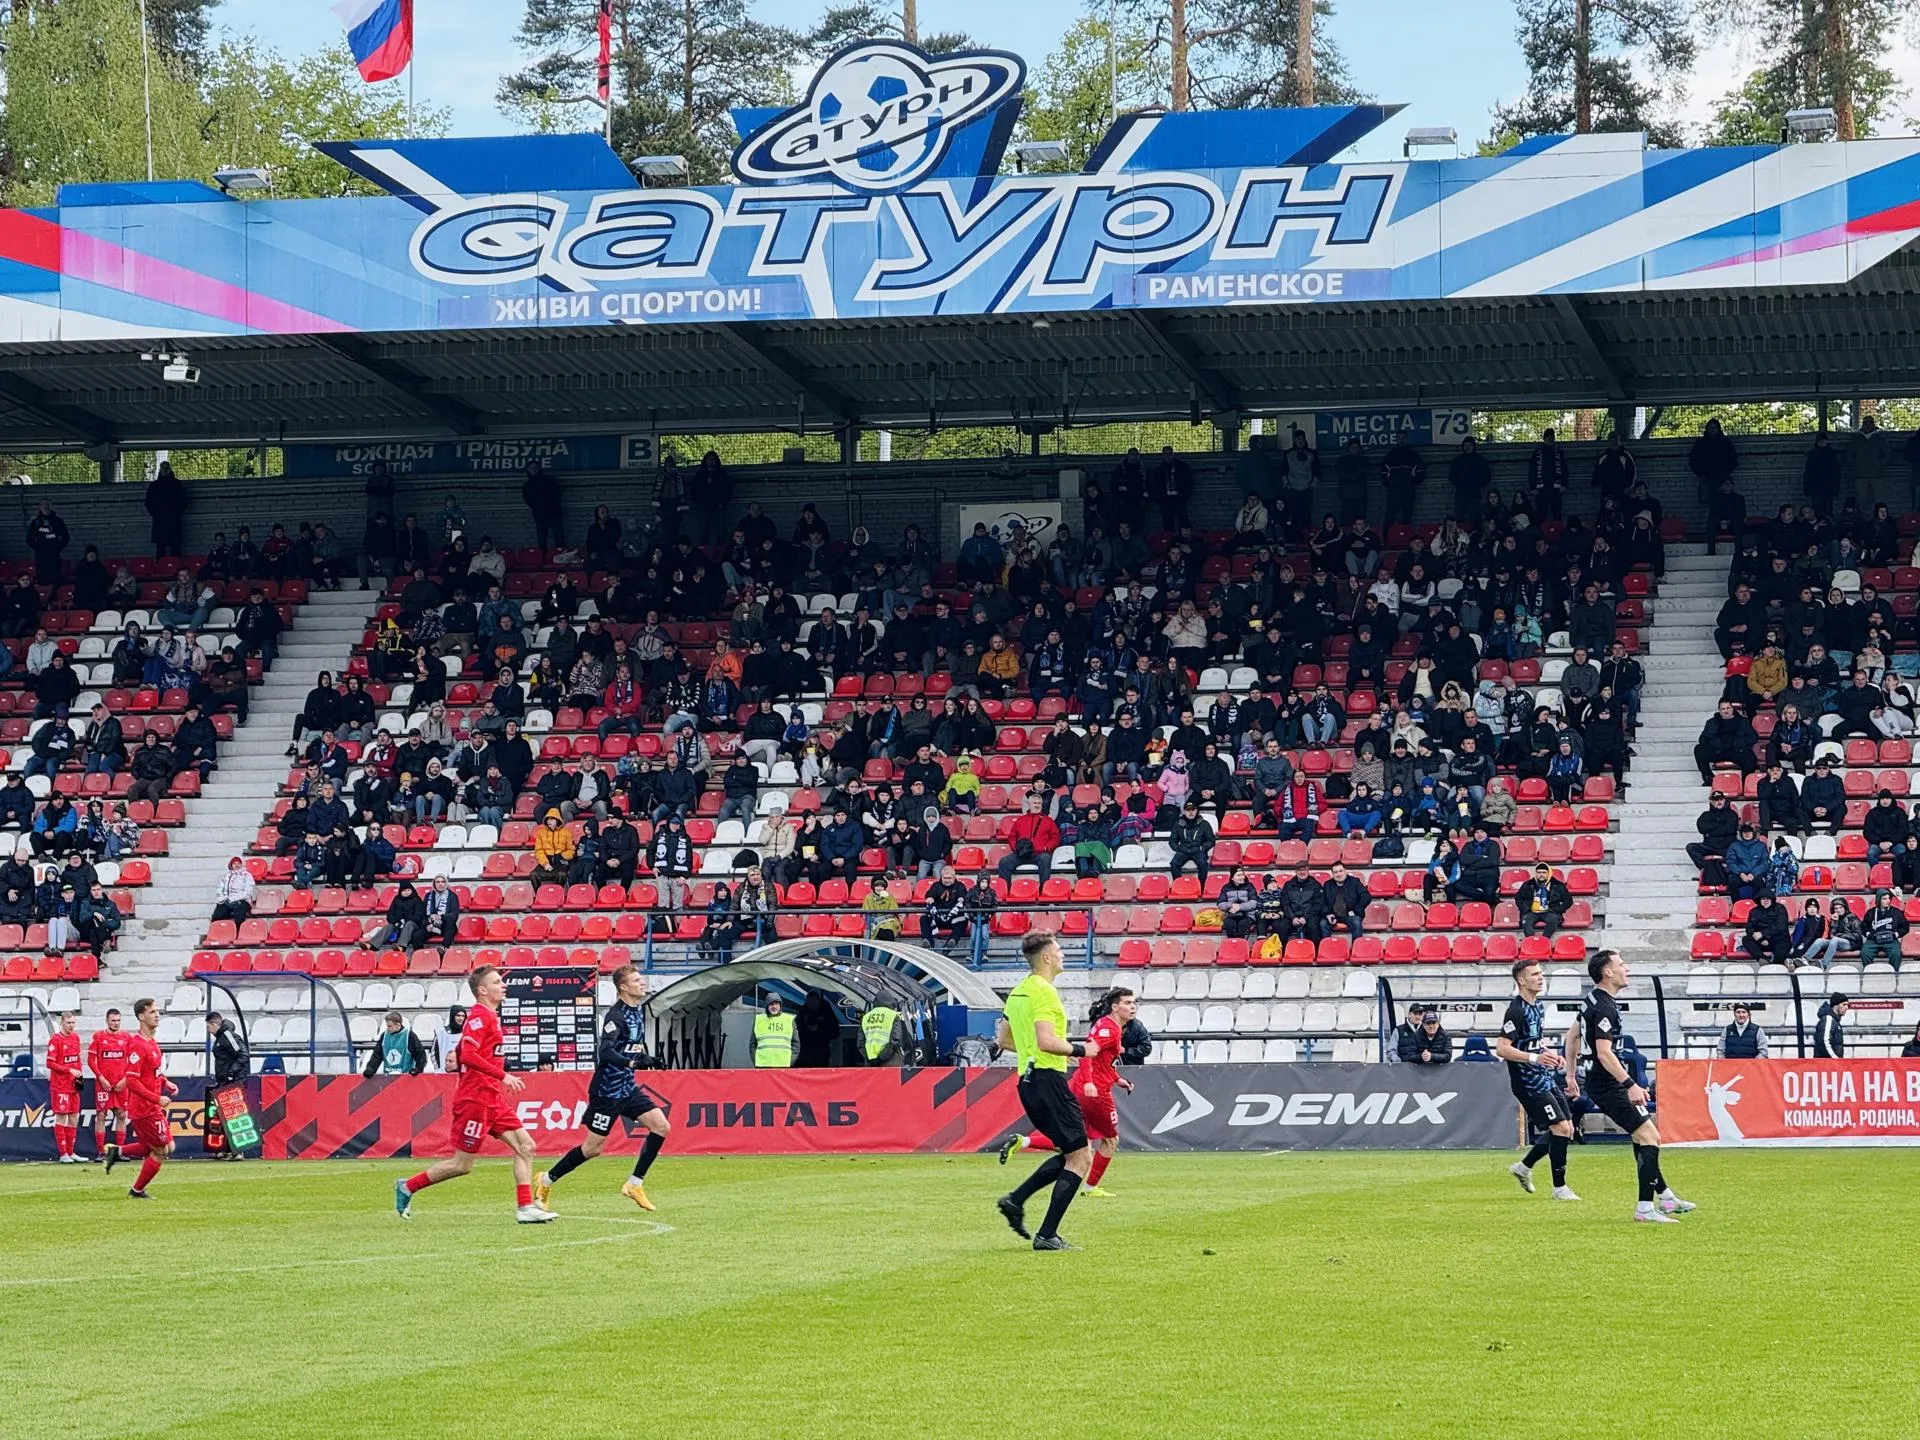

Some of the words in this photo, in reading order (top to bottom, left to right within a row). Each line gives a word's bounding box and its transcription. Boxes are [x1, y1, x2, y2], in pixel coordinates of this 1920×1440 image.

[1148, 273, 1344, 301] РАМЕНСКОЕ
[496, 294, 590, 322] ЖИВИ
[601, 287, 763, 318] СПОРТОМ!
[1332, 413, 1415, 434] МЕСТА
[1434, 412, 1469, 436] 73
[336, 442, 434, 462] ЮЖНАЯ
[352, 461, 413, 475] SOTH
[470, 457, 553, 470] TRIBUE
[1436, 1004, 1478, 1012] LEON
[768, 1022, 784, 1032] 4164
[867, 1013, 886, 1024] 4533
[58, 1093, 69, 1104] 74
[97, 1092, 109, 1102] 83
[1782, 1070, 1857, 1107] ОДНА
[1863, 1071, 1900, 1103] НА
[687, 1101, 817, 1128] ЛИГА
[828, 1100, 860, 1127] Б
[1228, 1092, 1458, 1127] DEMIX
[1543, 1104, 1556, 1120] 9
[1783, 1109, 1857, 1129] КОМАНДА,
[1859, 1108, 1920, 1128] РОДИНА,
[464, 1119, 482, 1139] 81
[592, 1112, 611, 1131] 22
